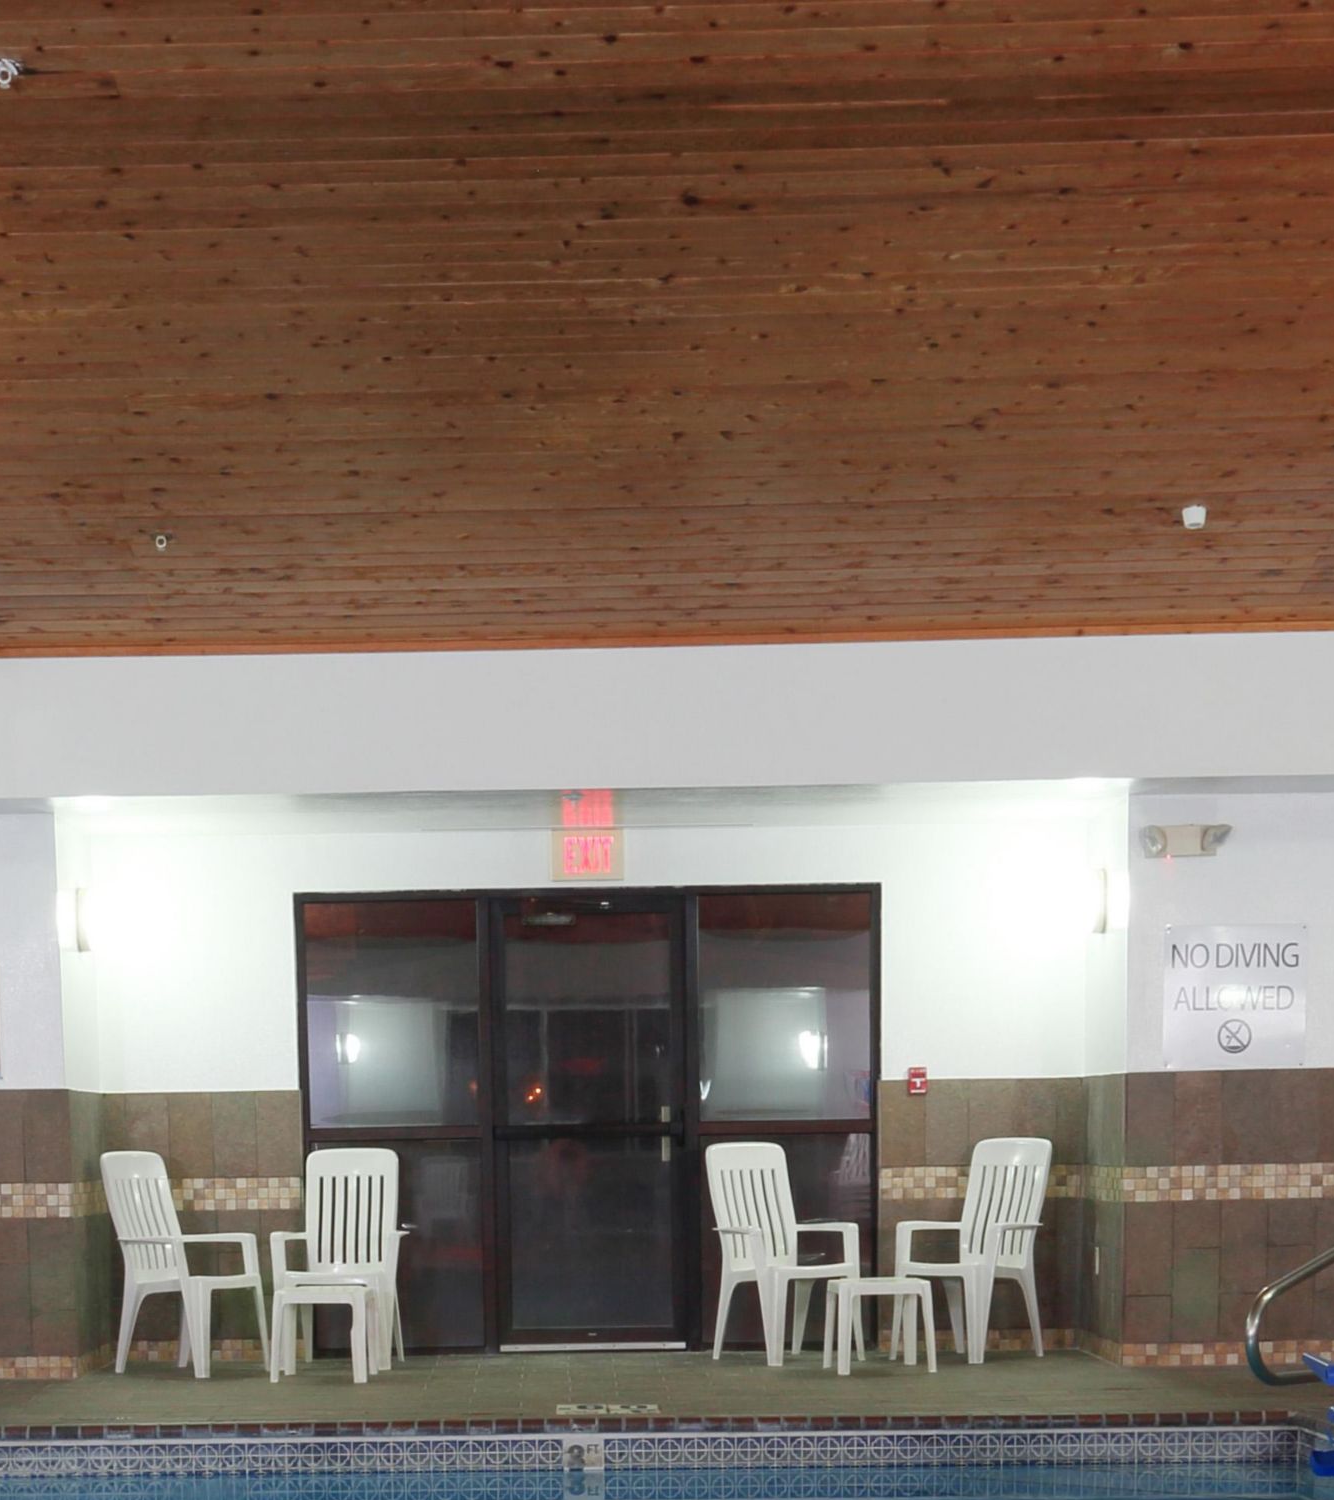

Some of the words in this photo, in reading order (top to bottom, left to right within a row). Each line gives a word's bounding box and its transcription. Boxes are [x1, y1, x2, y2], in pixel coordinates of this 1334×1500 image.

[563, 836, 614, 873] EXIT
[1171, 943, 1210, 968] NO
[1216, 942, 1300, 968] DIVING
[587, 1444, 599, 1454] FT
